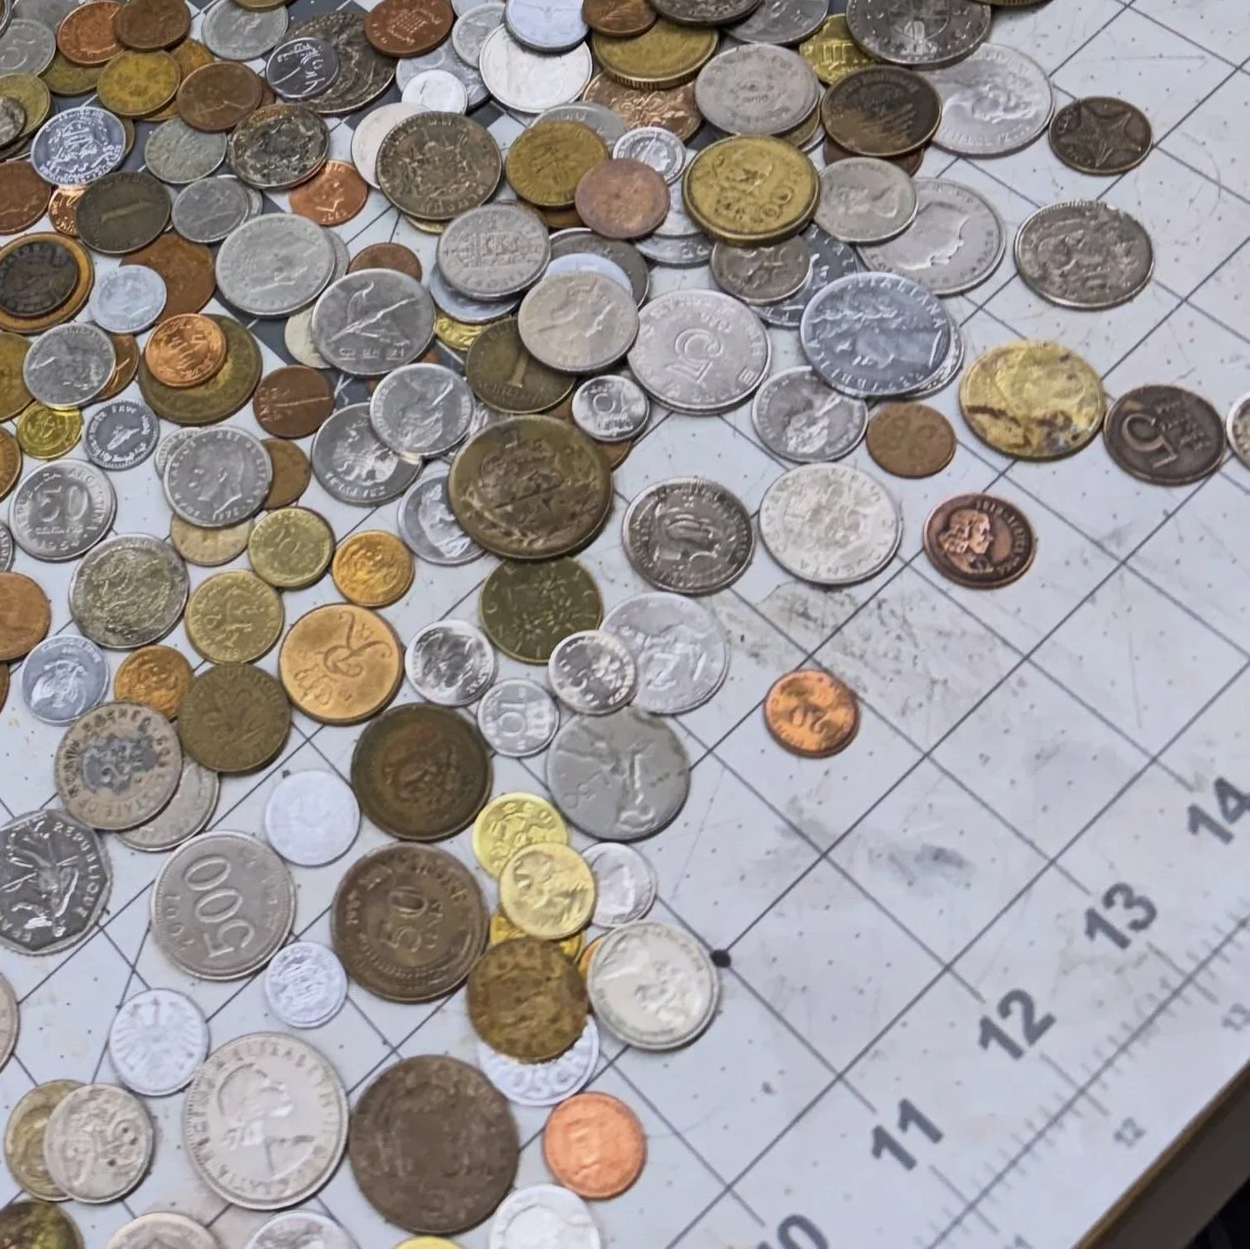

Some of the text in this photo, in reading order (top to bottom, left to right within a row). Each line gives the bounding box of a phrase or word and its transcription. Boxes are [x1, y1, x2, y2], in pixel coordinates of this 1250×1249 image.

[1125, 413, 1179, 469] 5
[1187, 776, 1250, 844] 14
[184, 857, 256, 959] 500
[1085, 883, 1158, 950] 13
[979, 989, 1057, 1060] 12
[871, 1098, 944, 1171] 11
[1113, 1116, 1147, 1150] 12
